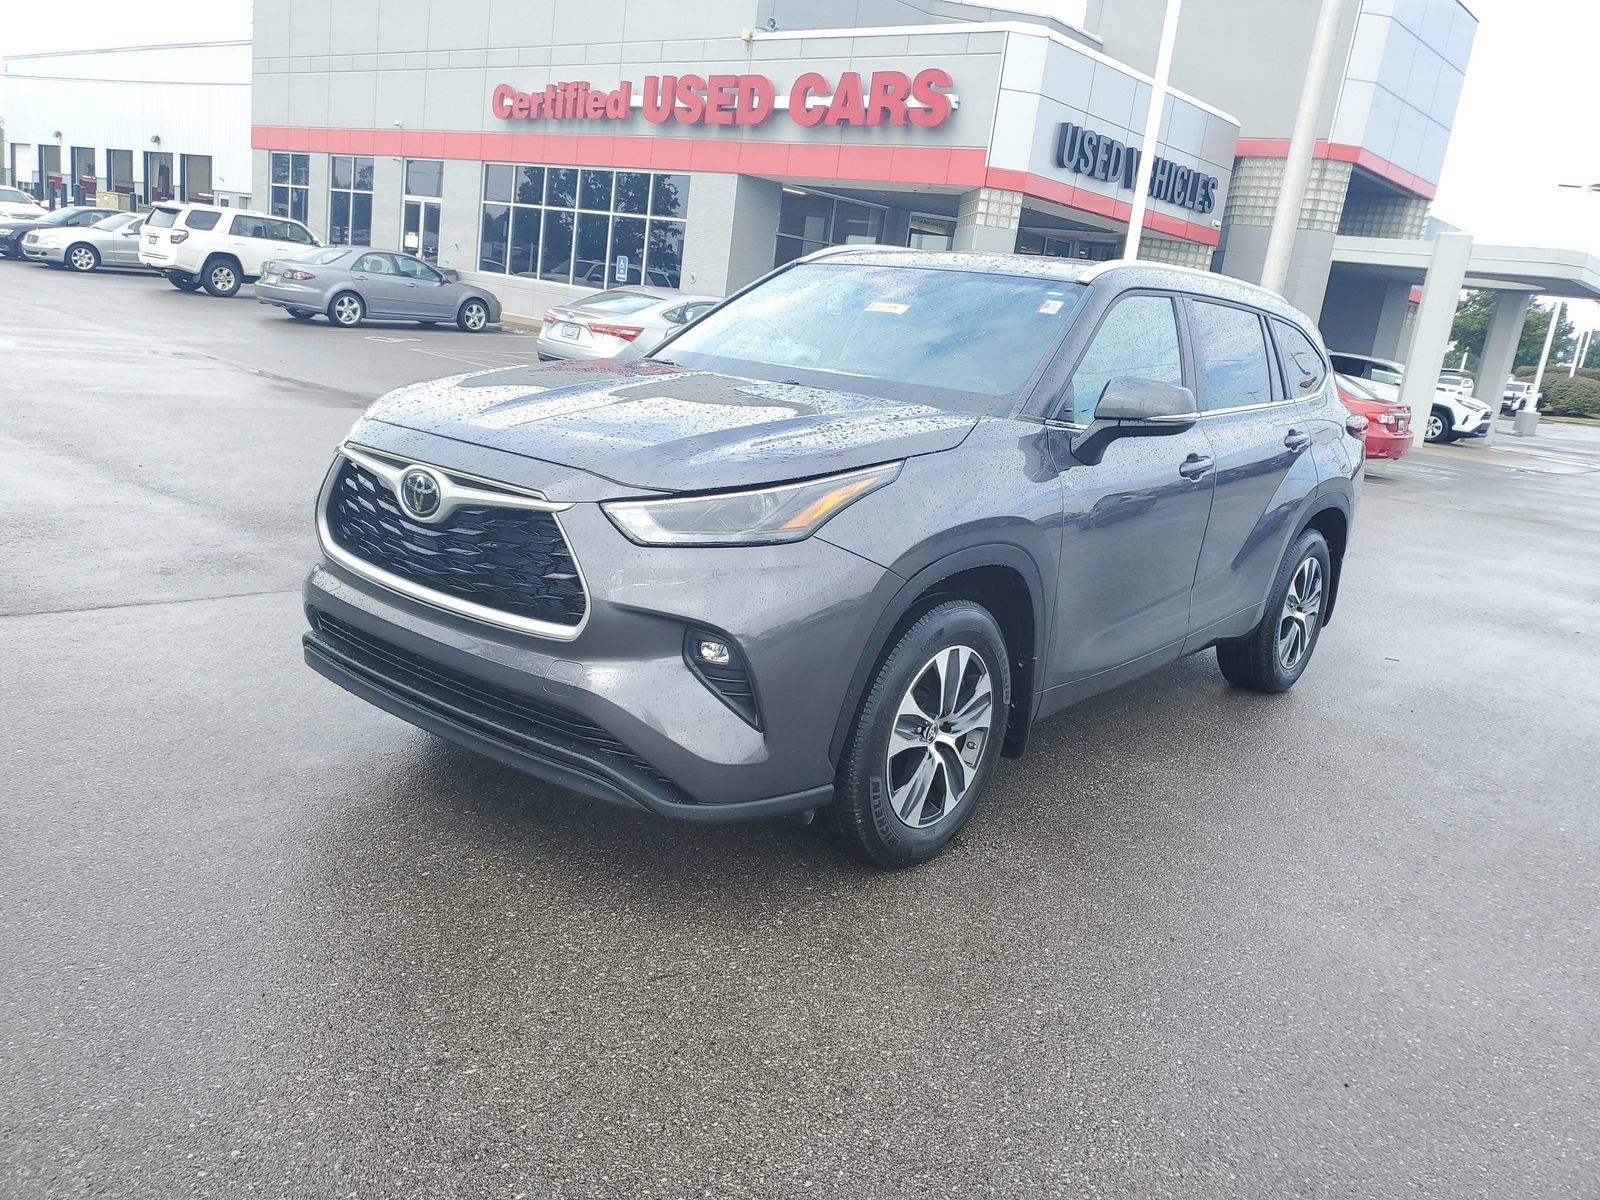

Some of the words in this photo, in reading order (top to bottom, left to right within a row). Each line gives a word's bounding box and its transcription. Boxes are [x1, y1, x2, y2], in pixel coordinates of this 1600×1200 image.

[492, 80, 632, 120] Certified
[643, 75, 775, 126] USED
[789, 68, 955, 128] CARS
[1057, 122, 1126, 182] USED
